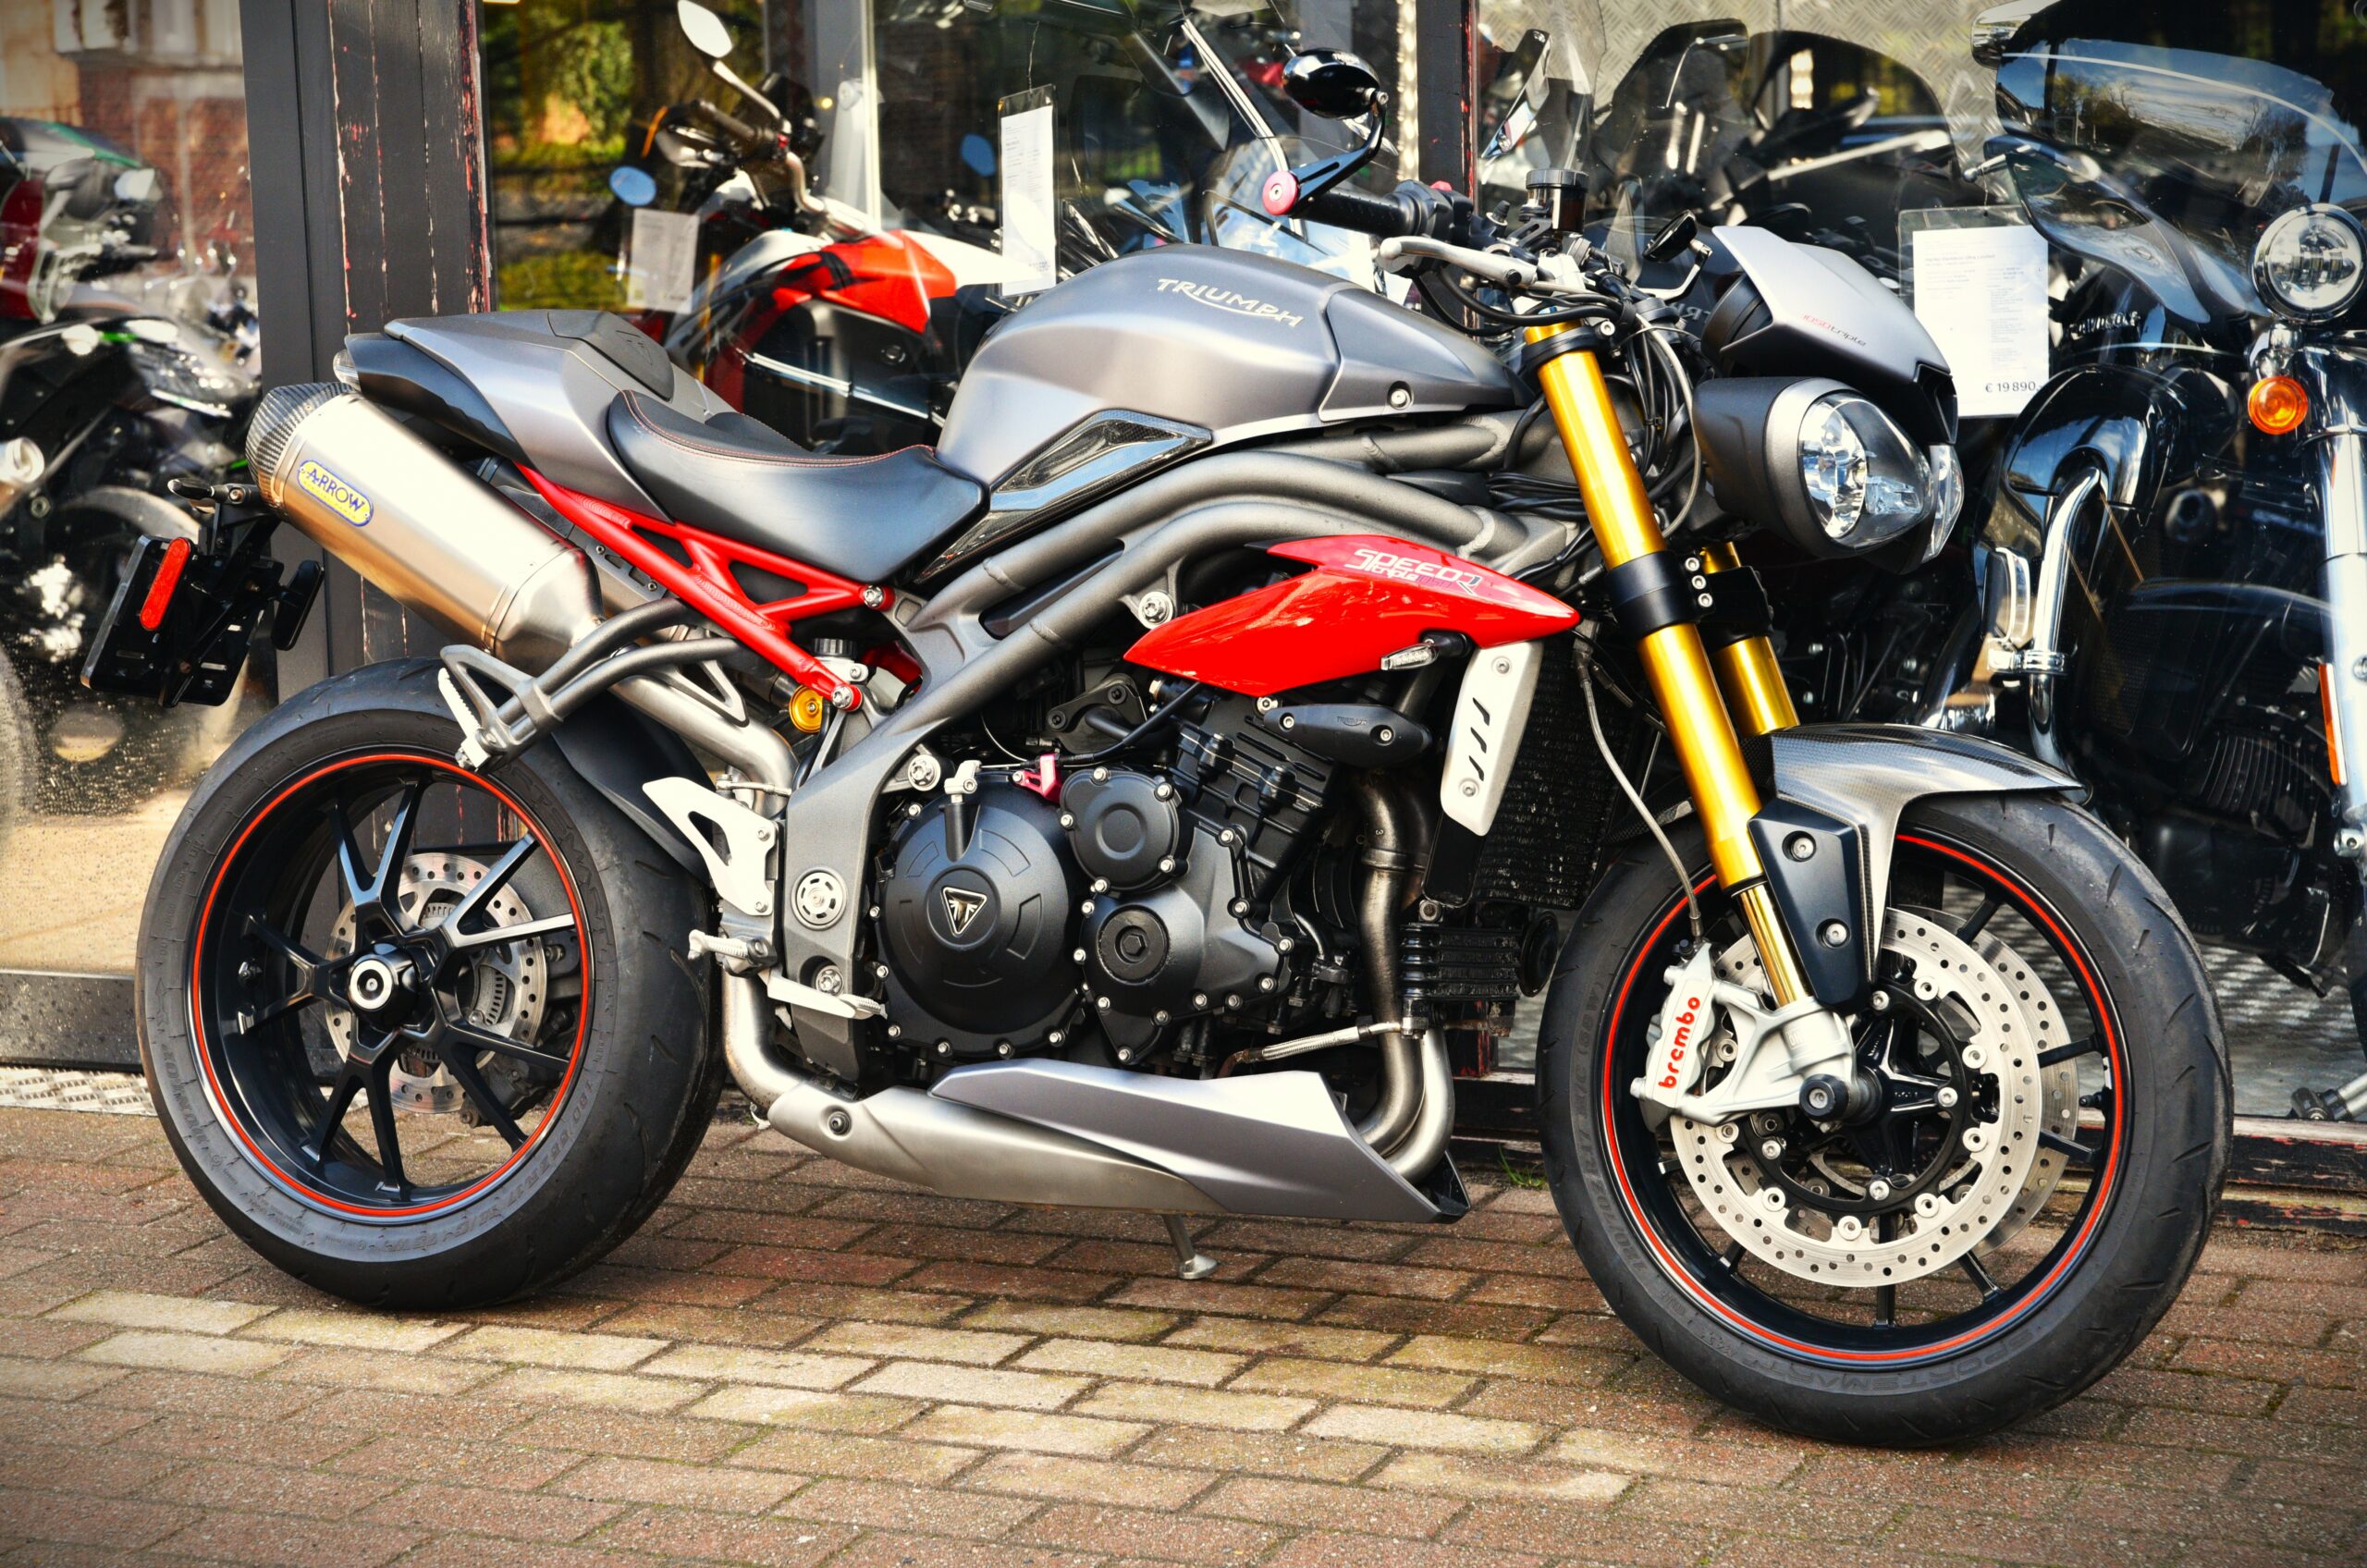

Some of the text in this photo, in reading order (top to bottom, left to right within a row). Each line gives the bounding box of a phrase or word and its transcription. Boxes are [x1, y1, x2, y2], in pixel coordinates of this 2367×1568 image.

[1158, 278, 1304, 327] TRIUMPH
[1985, 383, 1993, 393] €
[308, 467, 366, 512] ARROW
[1343, 548, 1465, 582] SPEED
[1658, 997, 1700, 1088] brembo
